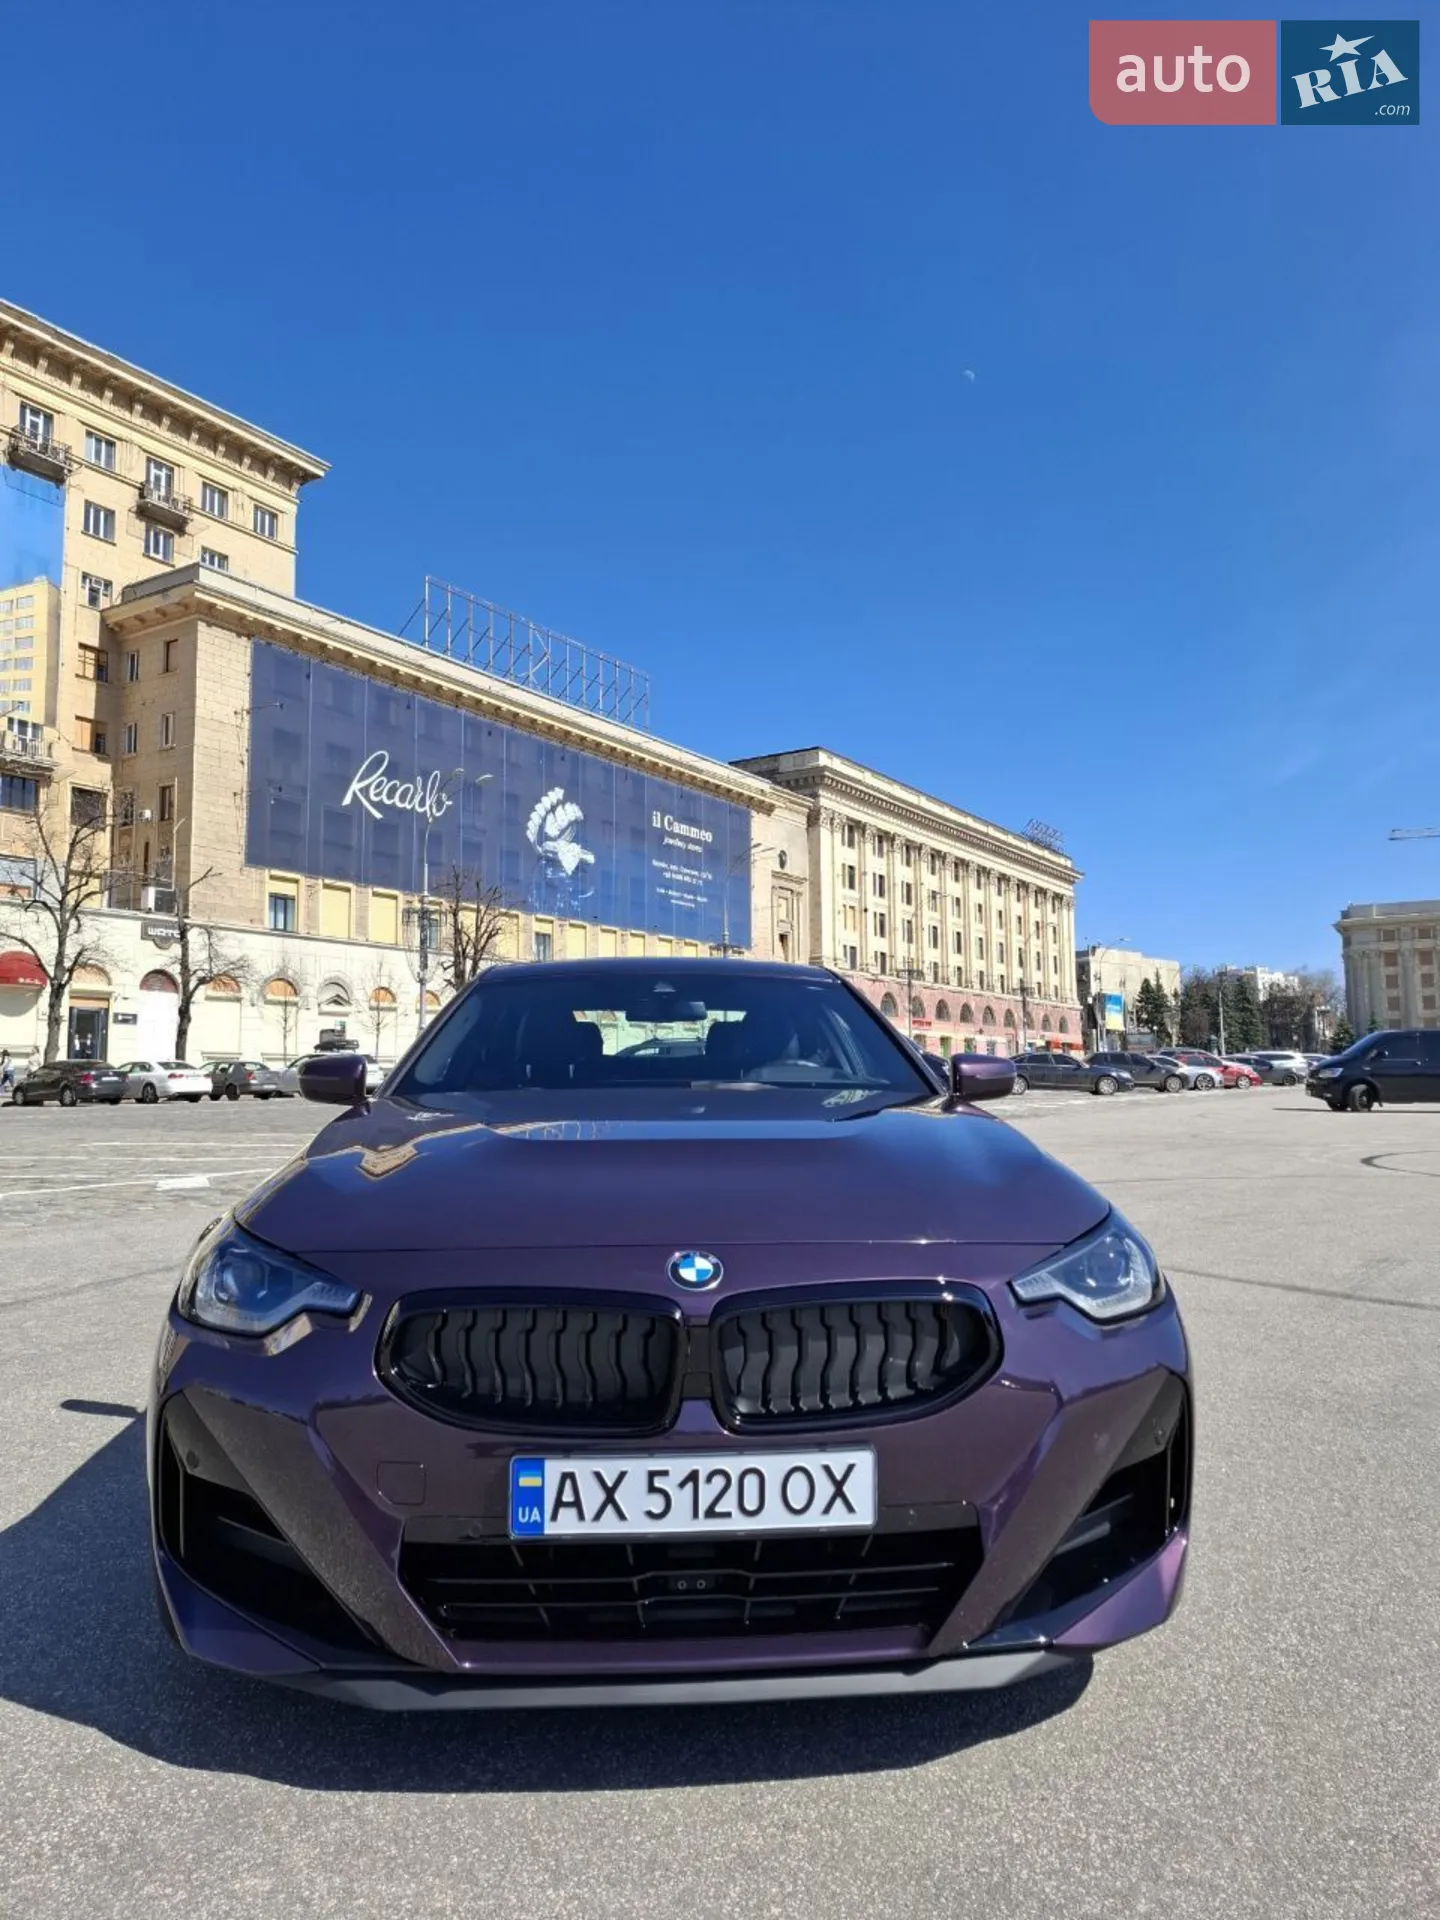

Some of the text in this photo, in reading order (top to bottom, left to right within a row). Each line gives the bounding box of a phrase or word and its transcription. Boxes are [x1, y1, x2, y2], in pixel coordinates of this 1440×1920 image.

[341, 750, 453, 820] Recarlo
[652, 810, 713, 843] il Cammeo
[518, 1506, 541, 1524] UA
[549, 1463, 857, 1524] AX 5120 OX
